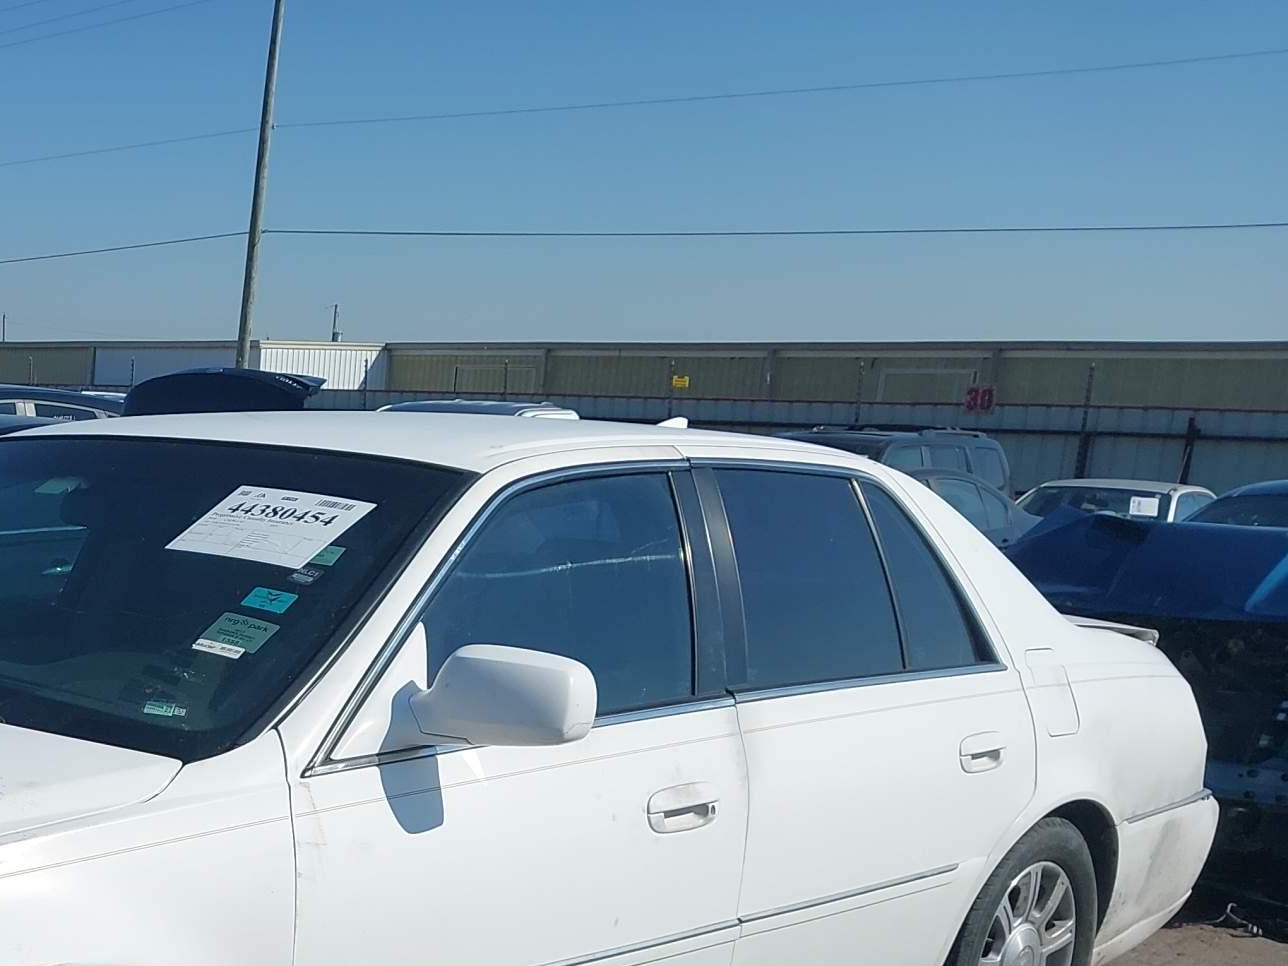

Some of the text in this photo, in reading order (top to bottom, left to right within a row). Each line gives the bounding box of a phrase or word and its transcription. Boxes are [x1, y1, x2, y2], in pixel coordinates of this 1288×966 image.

[965, 386, 994, 411] 30
[227, 501, 340, 526] 44380454
[247, 623, 269, 633] park
